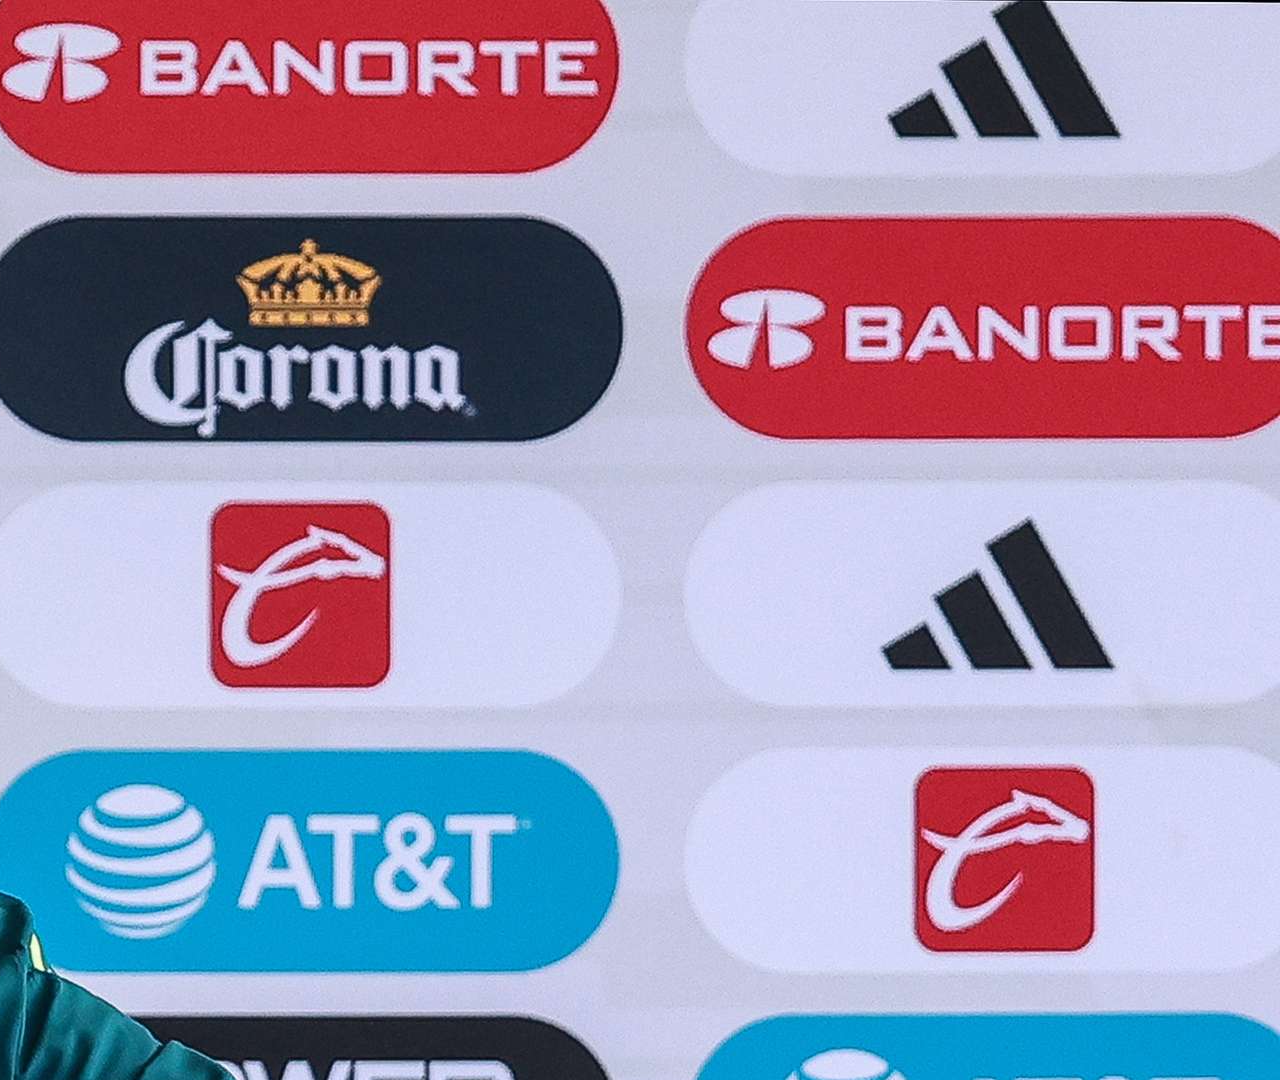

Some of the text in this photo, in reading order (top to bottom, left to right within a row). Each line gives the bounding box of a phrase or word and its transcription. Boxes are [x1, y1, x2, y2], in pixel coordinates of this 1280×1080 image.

[139, 39, 599, 97] BANORTE
[844, 304, 1280, 362] BANORTE
[124, 317, 468, 438] Corona
[238, 813, 517, 910] AT&T
